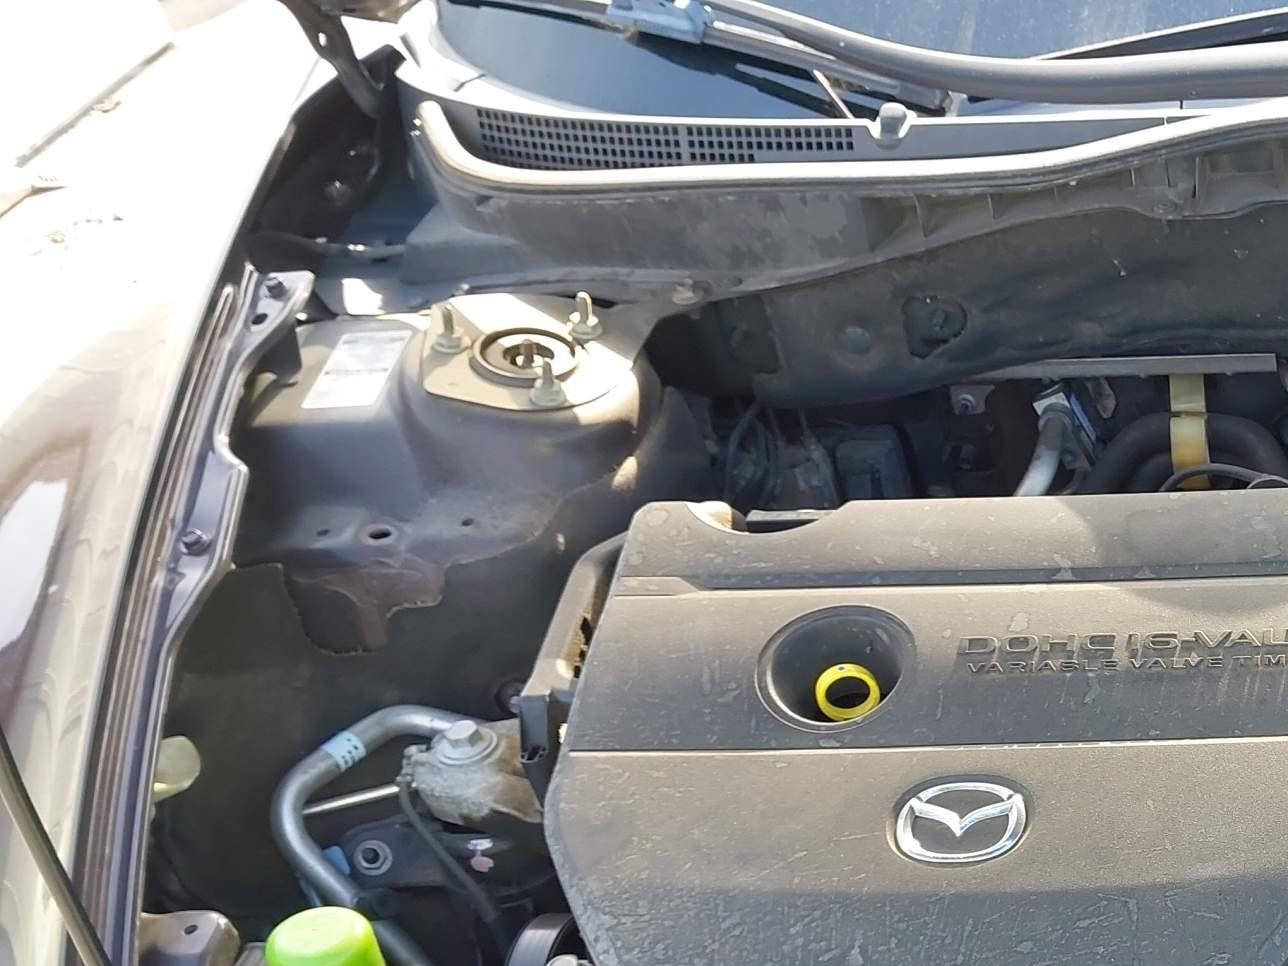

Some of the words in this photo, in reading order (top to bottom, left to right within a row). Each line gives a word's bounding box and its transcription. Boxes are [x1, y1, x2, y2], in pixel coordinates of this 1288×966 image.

[955, 631, 1118, 653] DOHC
[967, 659, 1121, 673] VARIABLE
[1129, 655, 1224, 669] VALVE
